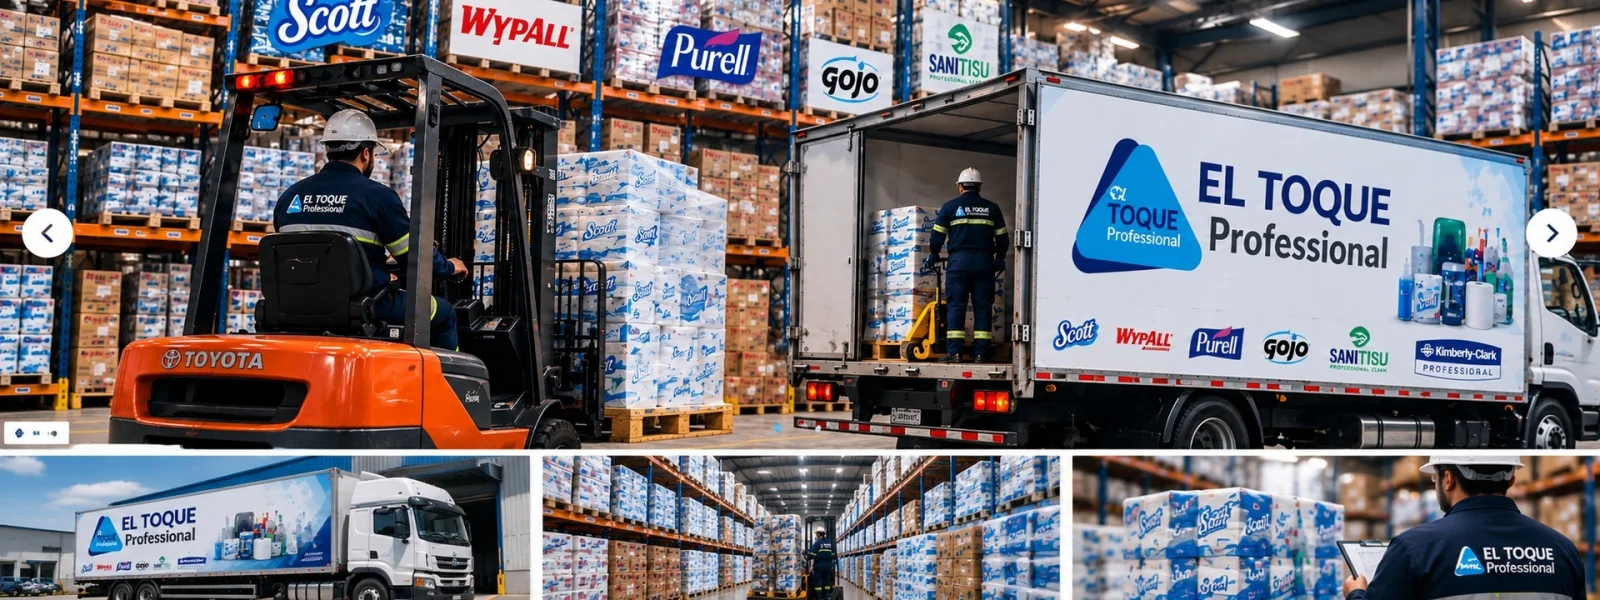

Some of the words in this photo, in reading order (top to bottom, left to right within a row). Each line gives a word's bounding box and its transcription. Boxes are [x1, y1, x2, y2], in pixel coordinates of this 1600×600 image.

[278, 0, 380, 44] Scott
[671, 33, 751, 76] Purell
[929, 53, 990, 78] SANITISU
[303, 195, 314, 204] EL
[316, 195, 348, 206] TOQUE
[1199, 161, 1246, 208] EL
[1258, 170, 1391, 227] TOQUE
[303, 204, 346, 213] Professional
[1107, 202, 1179, 231] TOQUE
[1107, 226, 1181, 248] Professional
[1210, 216, 1388, 269] Professional
[1054, 319, 1096, 348] Scott
[1196, 331, 1239, 355] Purell
[185, 351, 264, 370] TOYOTA
[1329, 348, 1389, 367] SANITISU
[1435, 346, 1497, 361] Kimberly-Clark
[122, 516, 138, 531] EL
[141, 507, 197, 529] TOQUE
[125, 527, 196, 546] Professional
[1483, 547, 1501, 560] EL
[1503, 547, 1555, 562] TOQUE
[1486, 561, 1555, 574] Professional
